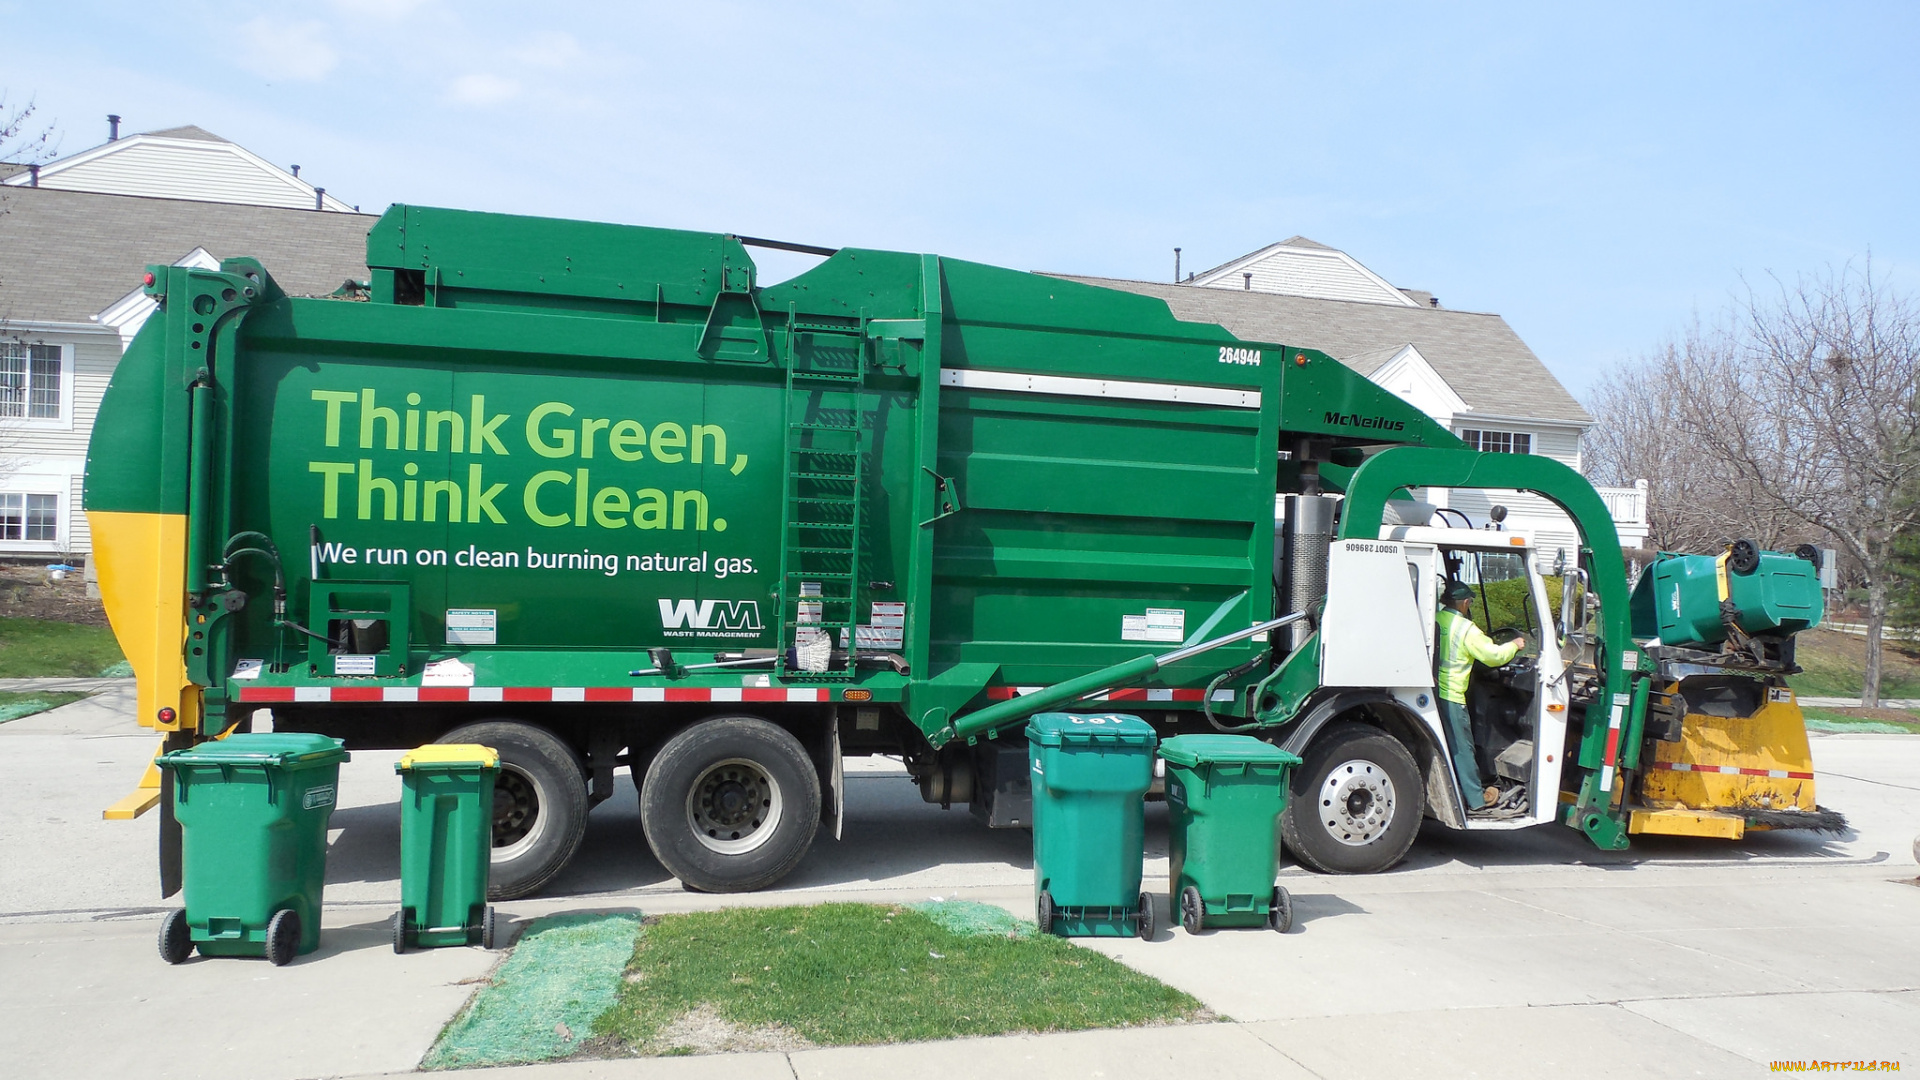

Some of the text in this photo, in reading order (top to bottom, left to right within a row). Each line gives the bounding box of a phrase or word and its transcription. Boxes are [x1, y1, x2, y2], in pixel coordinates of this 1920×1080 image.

[1218, 346, 1261, 366] 264944
[311, 388, 749, 477] Think Green,
[1323, 411, 1406, 431] McNeilus
[308, 459, 728, 533] Think Clean.
[316, 541, 759, 579] We run on clean burning natural gas.
[1375, 544, 1398, 554] USDOT
[658, 598, 761, 630] WM
[663, 630, 761, 639] WASTE MANAGEMENT
